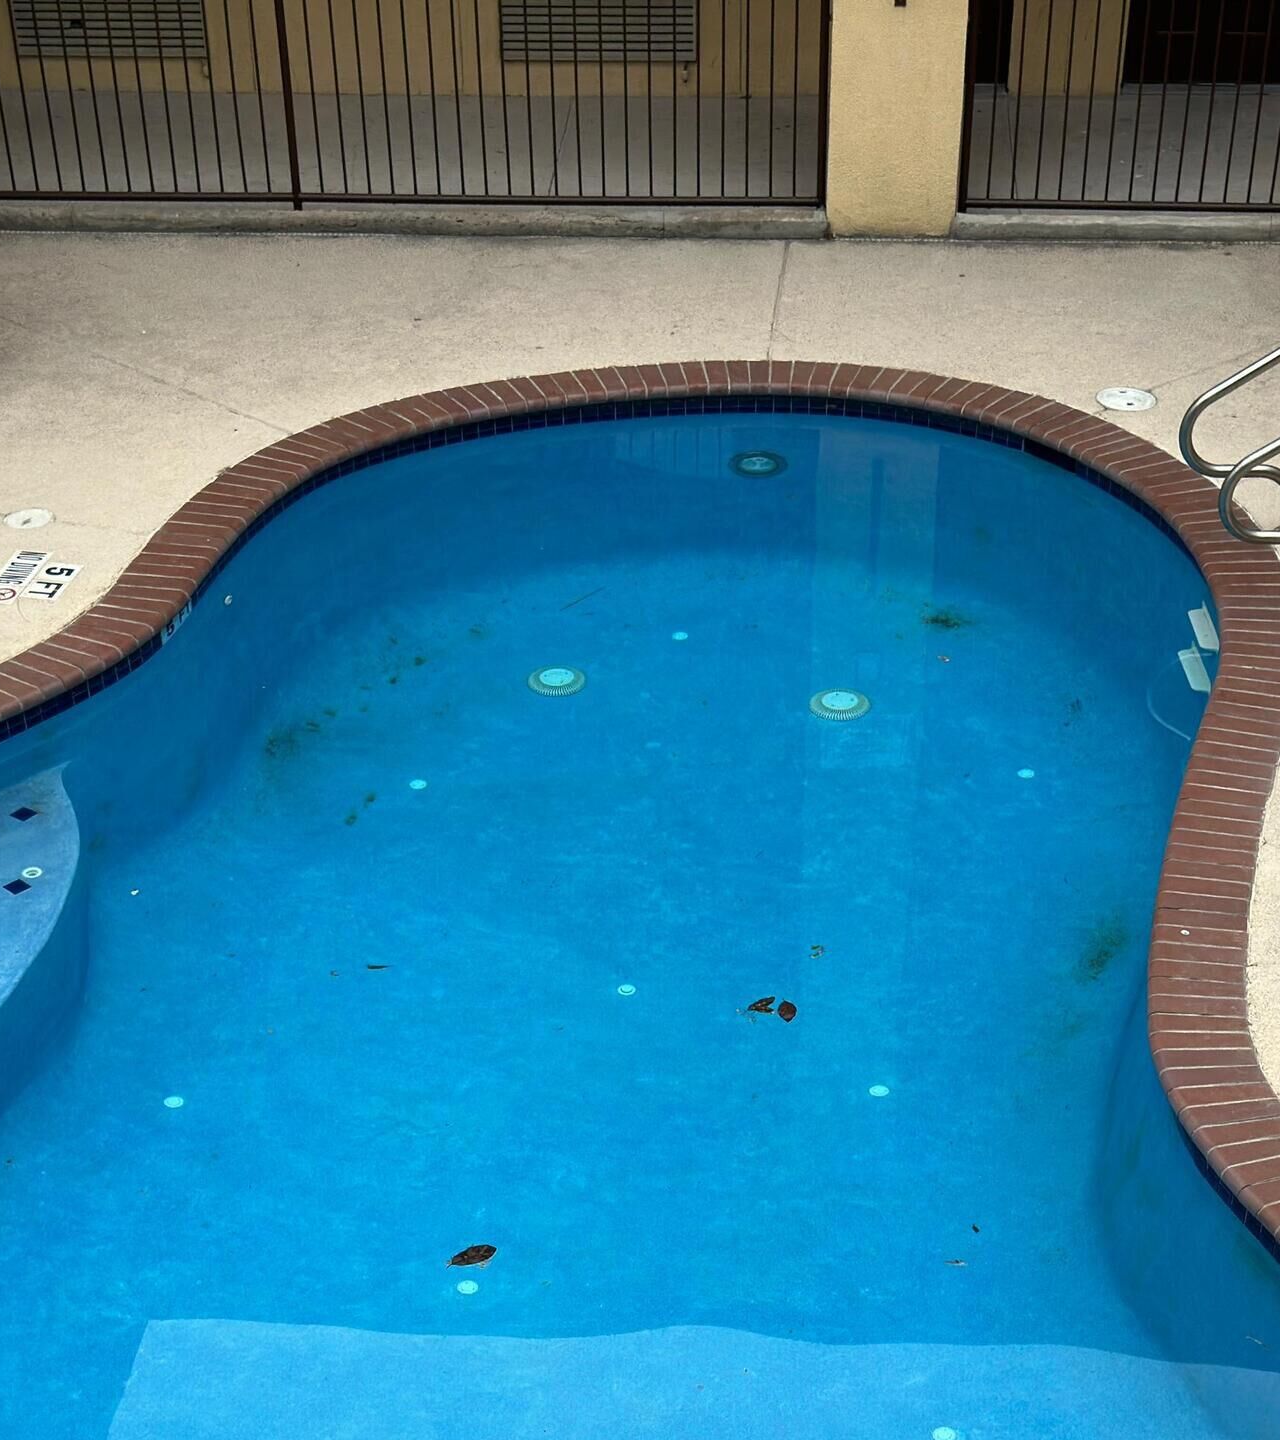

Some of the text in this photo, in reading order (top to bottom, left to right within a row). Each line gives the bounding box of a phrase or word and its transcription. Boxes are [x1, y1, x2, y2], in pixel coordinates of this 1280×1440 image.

[16, 550, 47, 562] NO
[28, 566, 75, 598] 5 FT
